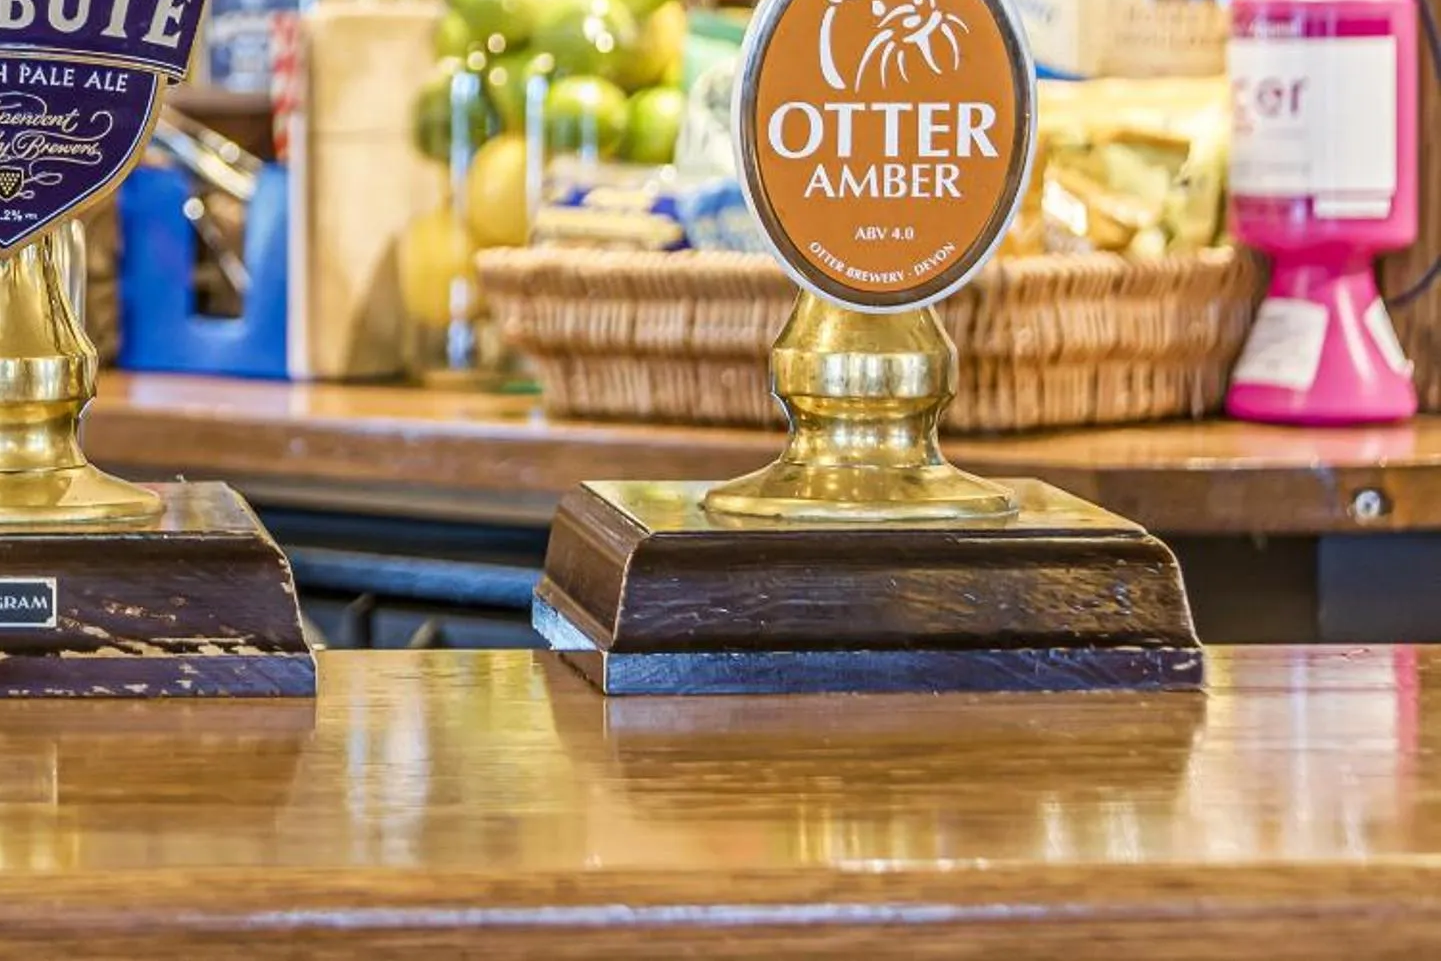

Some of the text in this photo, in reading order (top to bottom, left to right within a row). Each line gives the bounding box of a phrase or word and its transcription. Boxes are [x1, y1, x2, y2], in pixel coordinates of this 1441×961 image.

[19, 65, 75, 88] PALE
[84, 70, 129, 94] ALE
[767, 101, 999, 159] OTTER
[804, 164, 962, 198] AMBER
[854, 226, 915, 240] ABV 4.0
[809, 241, 957, 284] OTTER BREWERY DEVON
